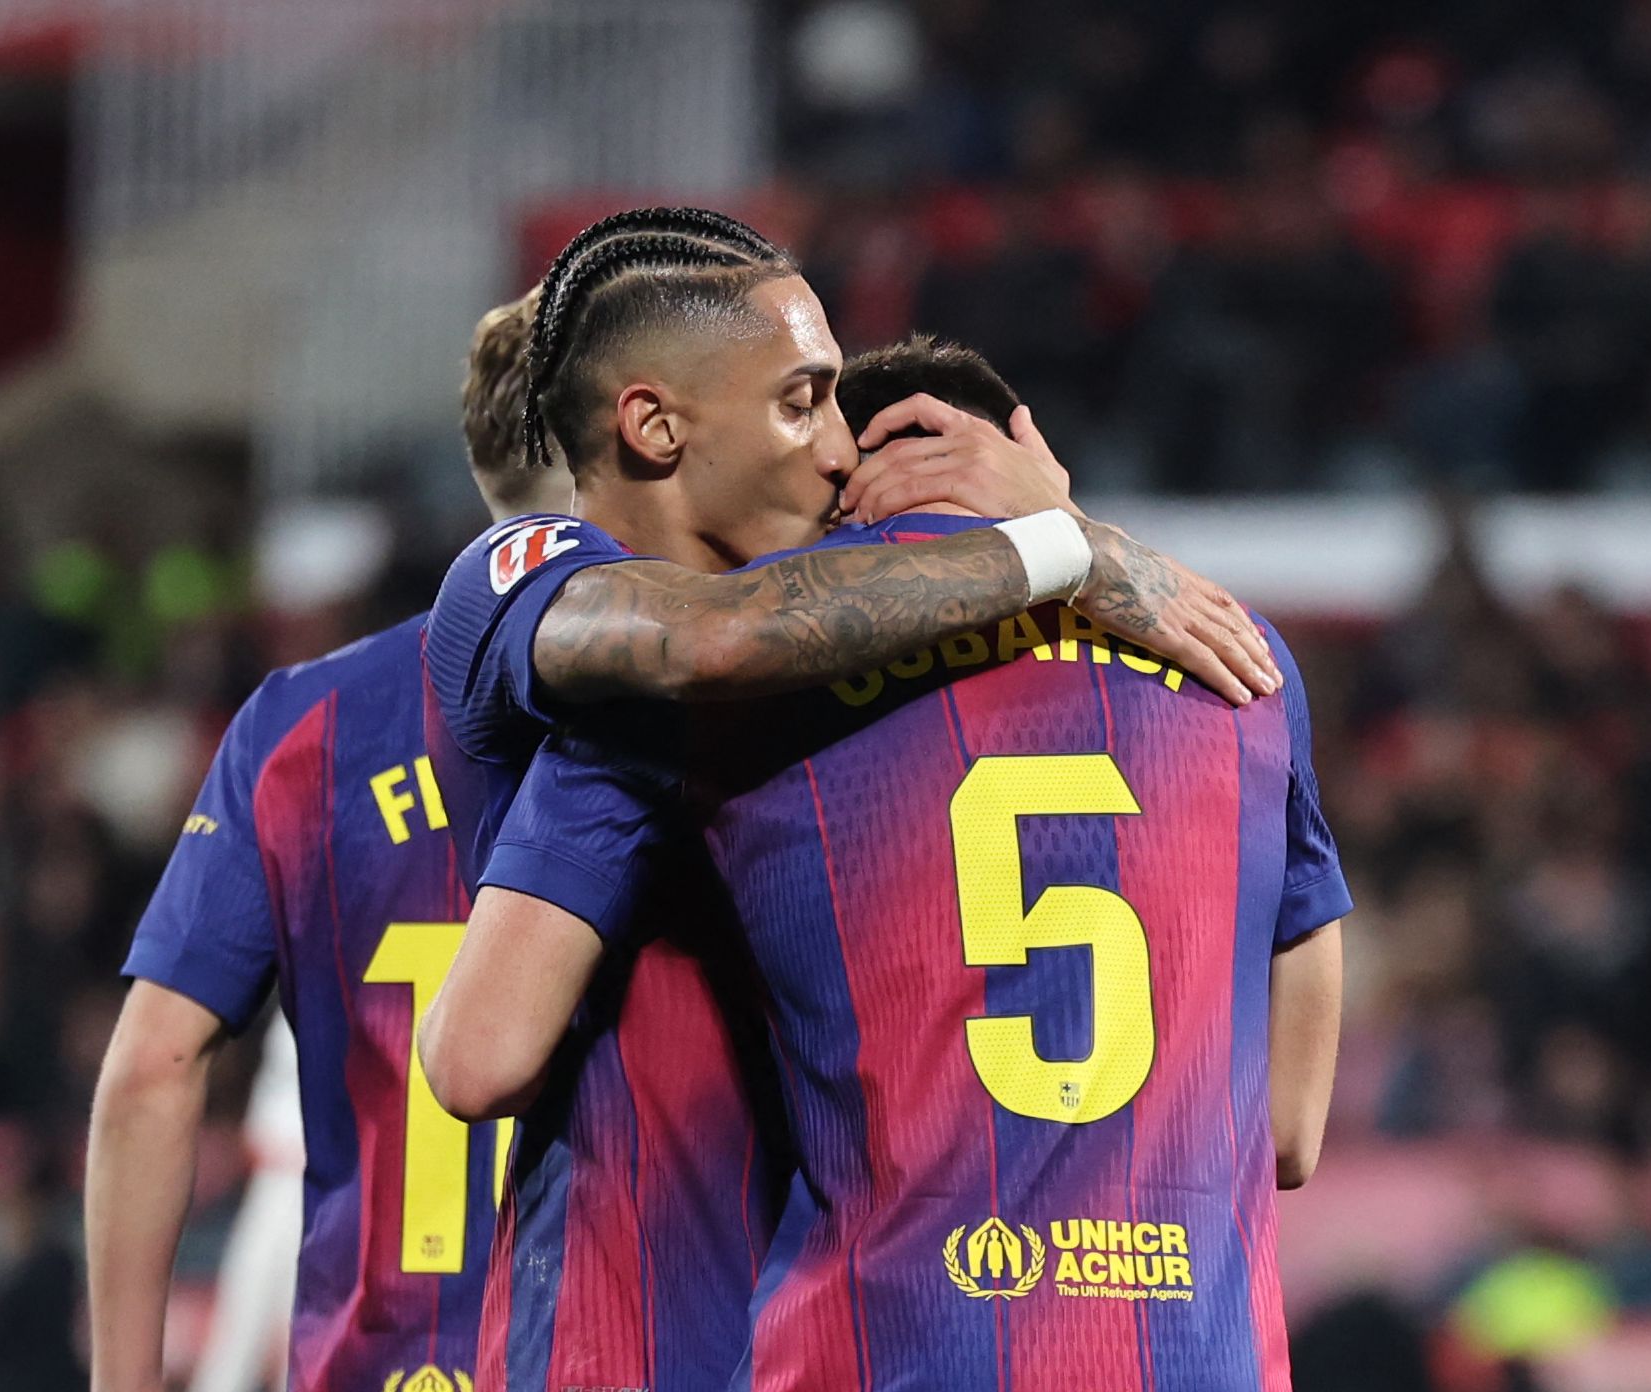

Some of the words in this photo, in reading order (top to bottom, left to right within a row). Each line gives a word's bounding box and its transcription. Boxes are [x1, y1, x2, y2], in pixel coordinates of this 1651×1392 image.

[949, 753, 1158, 1125] 5
[1049, 1218, 1189, 1254] UNHCR
[1054, 1252, 1194, 1287] ACNUR
[1056, 1284, 1078, 1297] The
[1081, 1285, 1098, 1298] UN
[1100, 1287, 1148, 1300] Refugee
[1149, 1288, 1194, 1303] Agency
